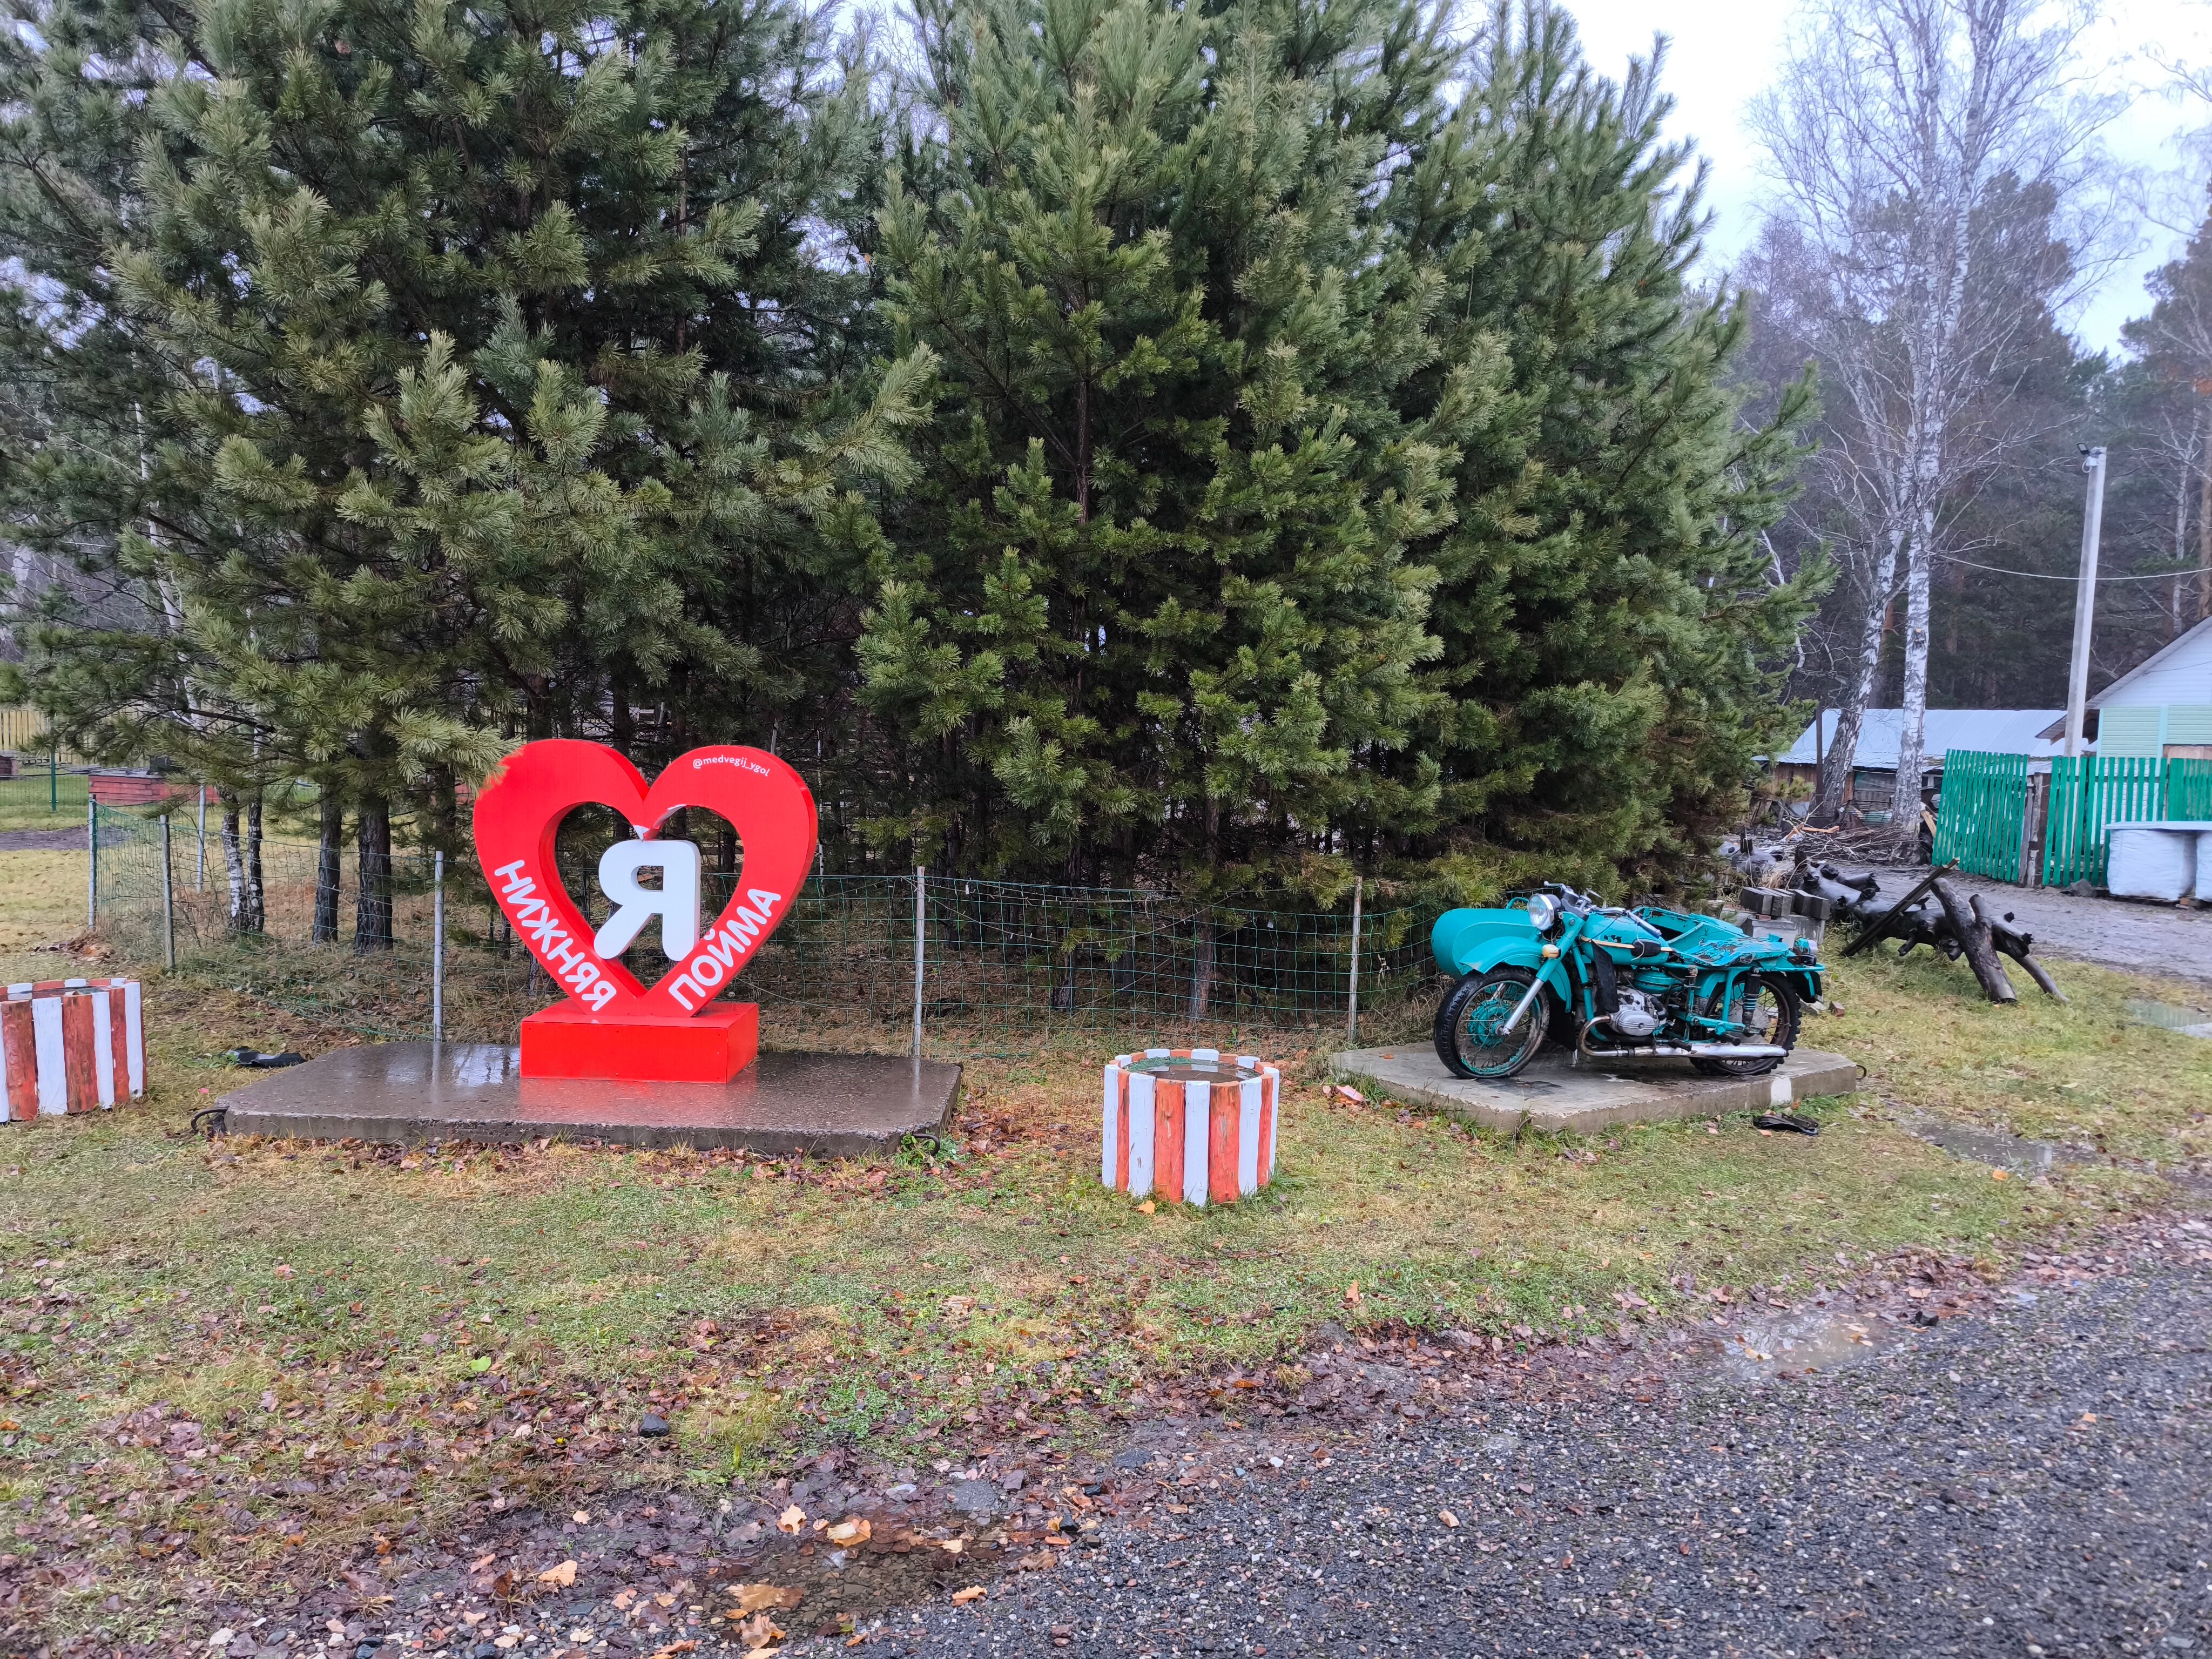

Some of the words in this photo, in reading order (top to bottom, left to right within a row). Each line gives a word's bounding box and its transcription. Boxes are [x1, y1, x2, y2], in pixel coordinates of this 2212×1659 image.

[692, 754, 771, 777] @medvegij_ygol
[495, 860, 616, 1011] НИЖНЯЯ
[668, 888, 781, 1010] ПОЙМА
[594, 840, 700, 961] Я
